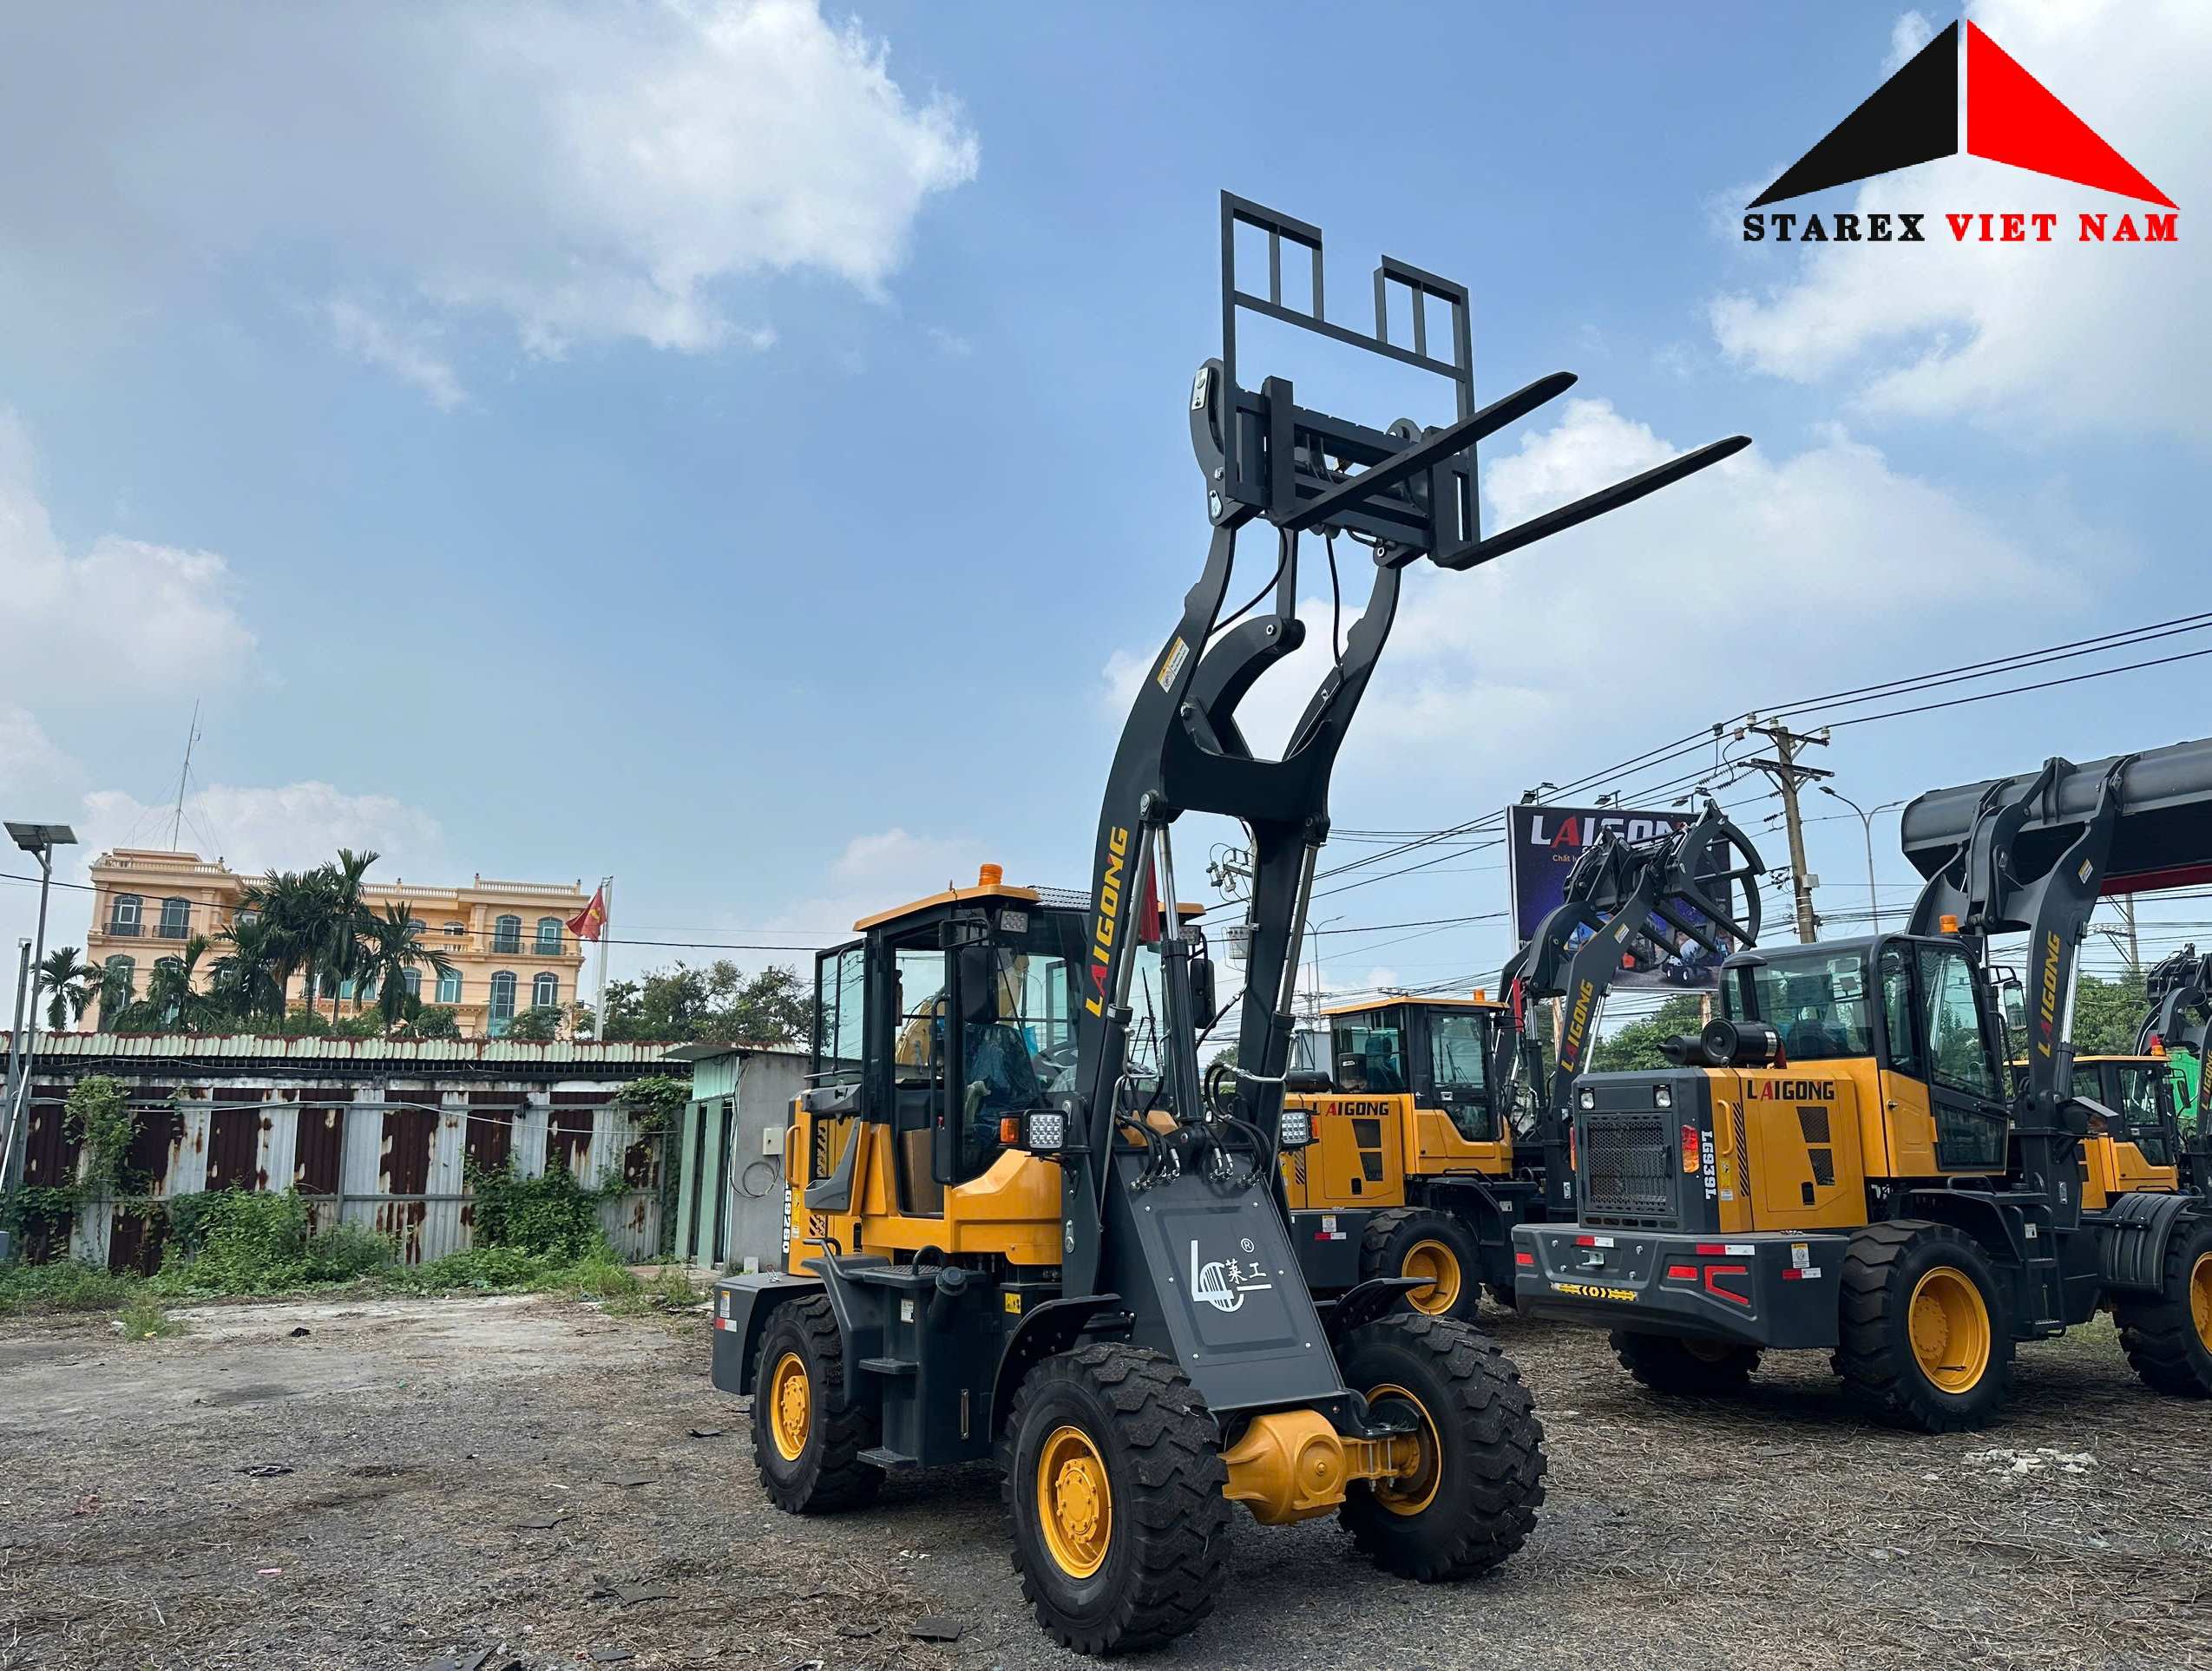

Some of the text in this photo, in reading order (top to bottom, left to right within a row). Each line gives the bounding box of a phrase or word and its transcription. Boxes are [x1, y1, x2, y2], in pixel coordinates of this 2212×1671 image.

[1085, 825, 1129, 1019] LAIGONG
[1560, 979, 1594, 1073] LAIGONG
[2038, 929, 2061, 1058] LAIGONG
[1312, 1101, 1389, 1117] LAIGONG
[1747, 1079, 1835, 1102] LAIGONG
[1701, 1130, 1716, 1200] LG939L
